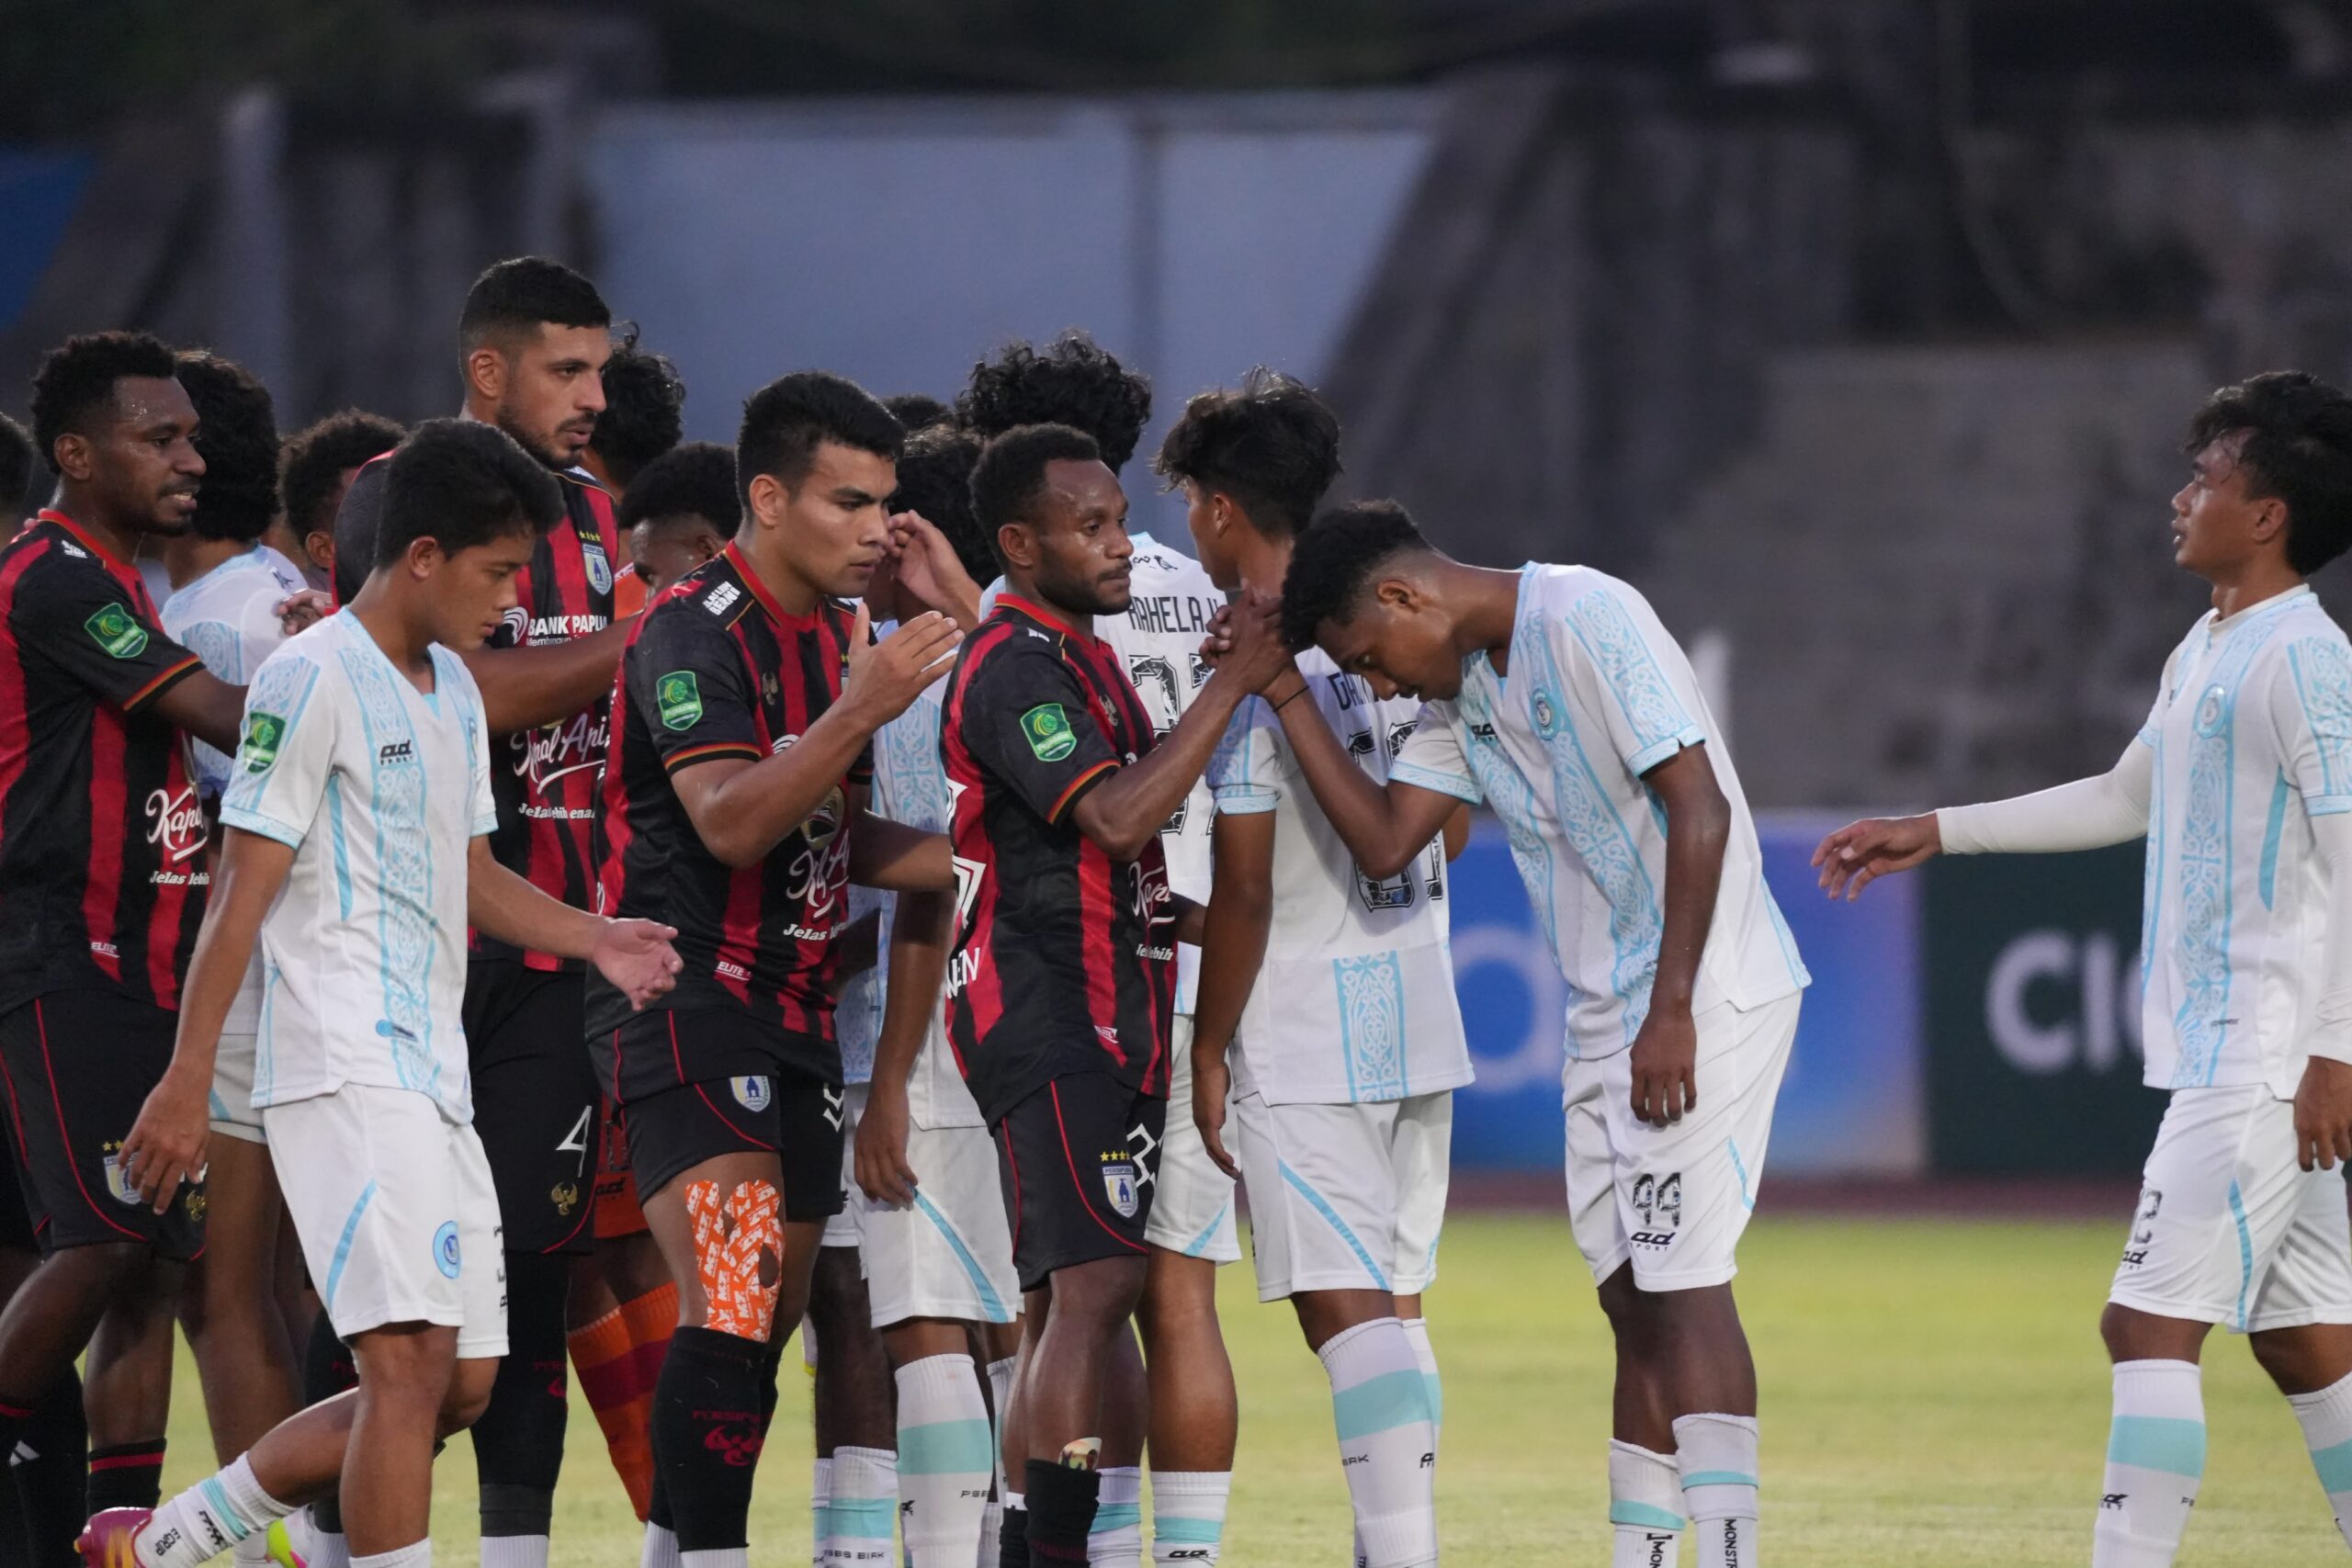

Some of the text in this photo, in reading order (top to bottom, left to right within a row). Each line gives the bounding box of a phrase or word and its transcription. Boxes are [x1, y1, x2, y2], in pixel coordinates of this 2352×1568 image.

[527, 616, 570, 636] BANK
[570, 808, 595, 819] ena
[150, 871, 187, 885] Jelas
[783, 924, 828, 941] Jelas
[717, 961, 745, 976] ELITE
[556, 1105, 592, 1178] 4
